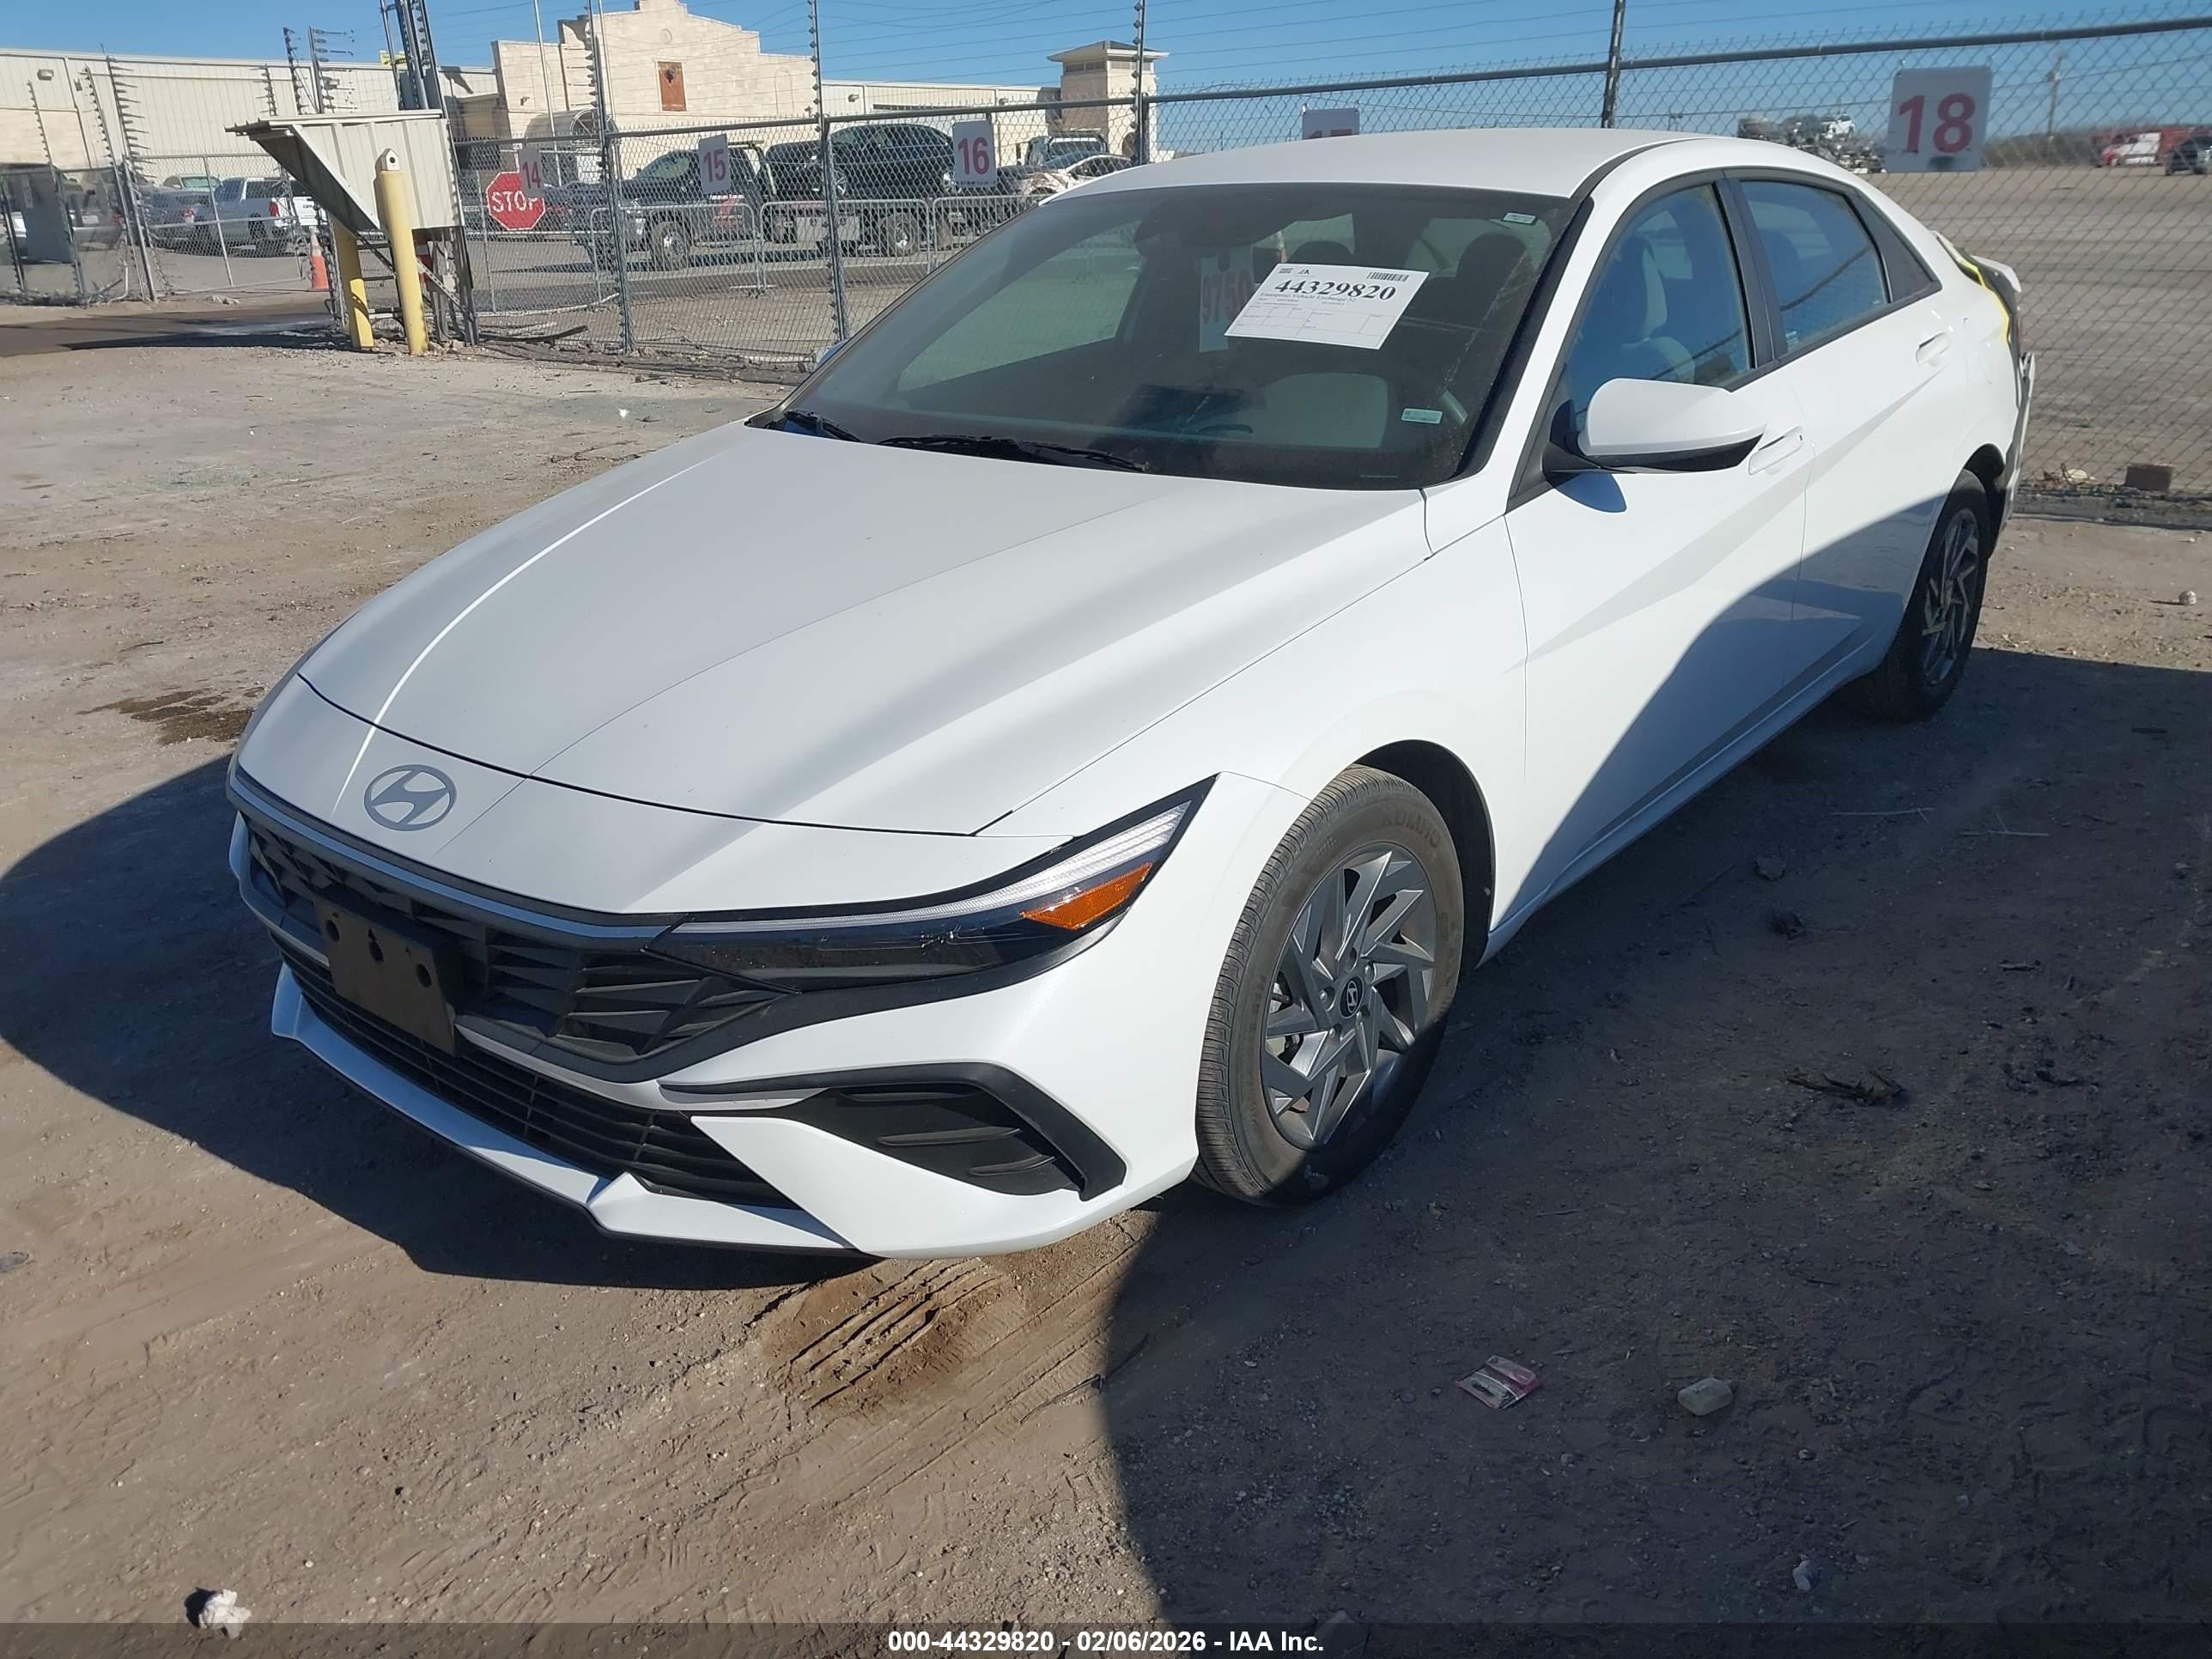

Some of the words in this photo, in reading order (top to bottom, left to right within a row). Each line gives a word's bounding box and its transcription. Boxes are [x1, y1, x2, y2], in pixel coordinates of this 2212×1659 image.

[1899, 93, 1975, 154] 18
[703, 148, 725, 183] 15
[958, 137, 989, 175] 16
[523, 161, 542, 189] 14
[1274, 279, 1397, 301] 44329820
